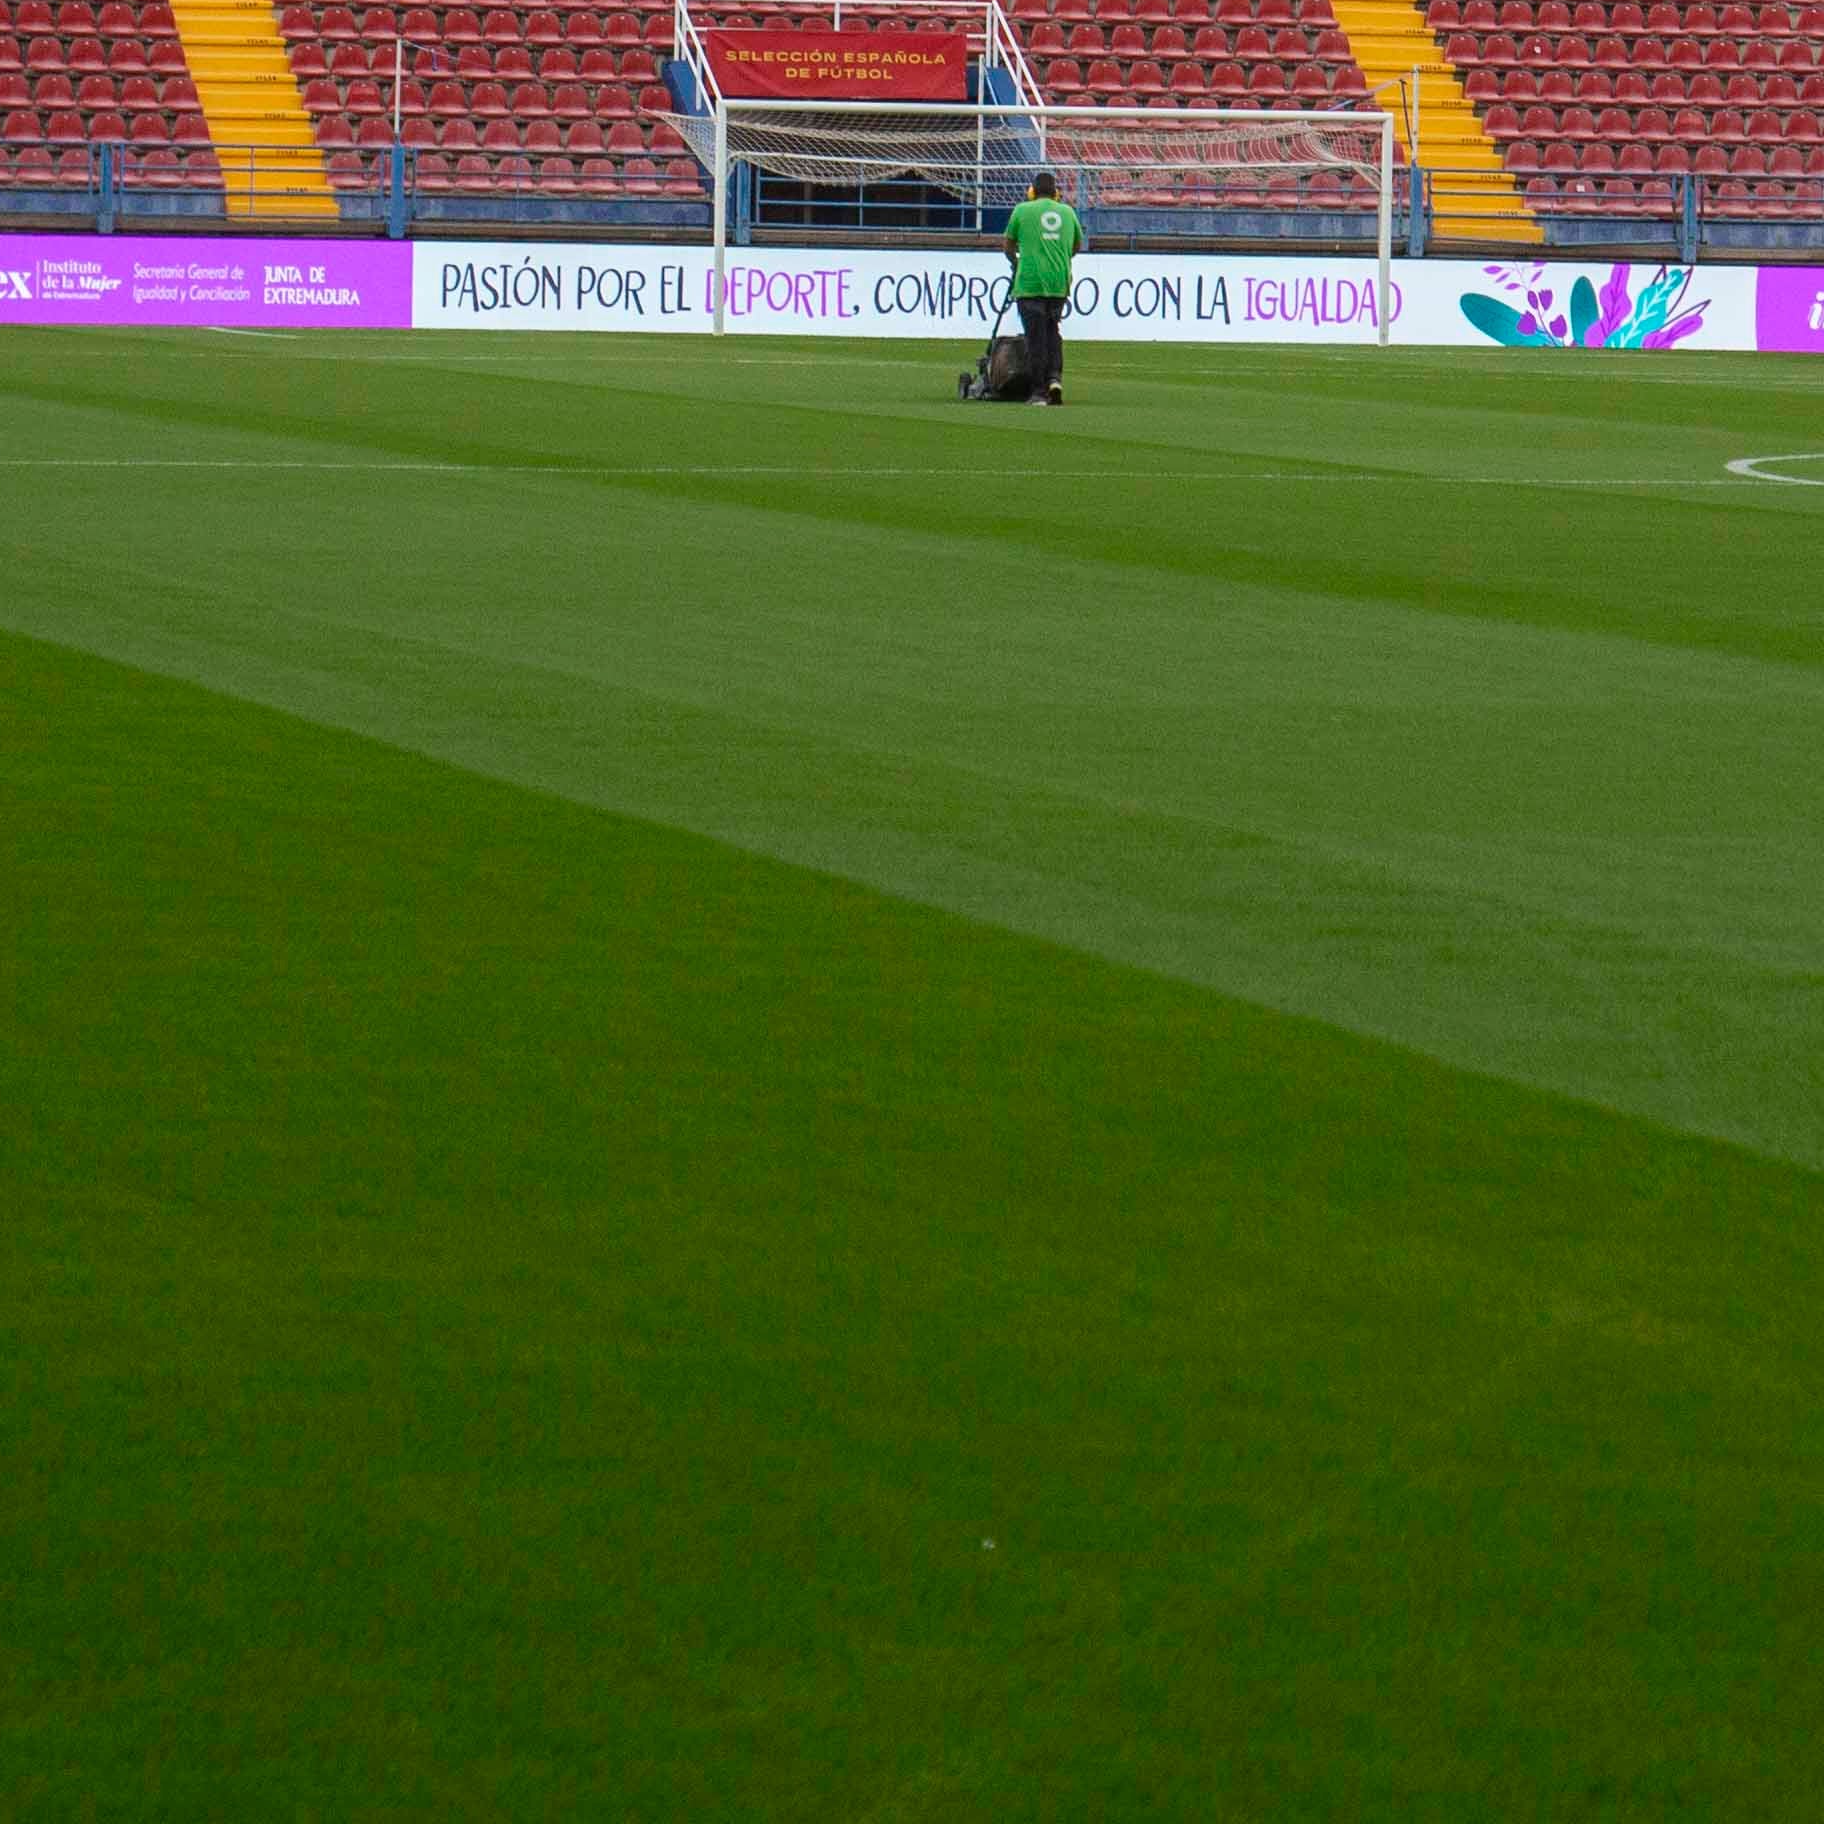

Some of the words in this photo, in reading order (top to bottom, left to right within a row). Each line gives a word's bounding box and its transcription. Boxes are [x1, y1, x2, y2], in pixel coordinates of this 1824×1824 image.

[725, 48, 837, 64] SELECCIÓN
[843, 49, 947, 65] ESPAÑOLA
[784, 66, 812, 79] DE
[817, 64, 894, 80] FÚTBOL
[42, 258, 102, 275] Instituto
[187, 263, 228, 281] General
[263, 264, 304, 286] JUNTA
[309, 265, 326, 284] DE
[42, 274, 59, 290] de
[62, 274, 75, 290] la
[78, 275, 122, 293] Mujer
[441, 255, 562, 312] PASIÓN
[577, 265, 646, 315] POR
[660, 265, 692, 314] EL
[875, 270, 1099, 323] COMPROO
[1113, 275, 1182, 322] CON
[1196, 274, 1231, 325] LA
[263, 287, 361, 306] EXTREMADURA
